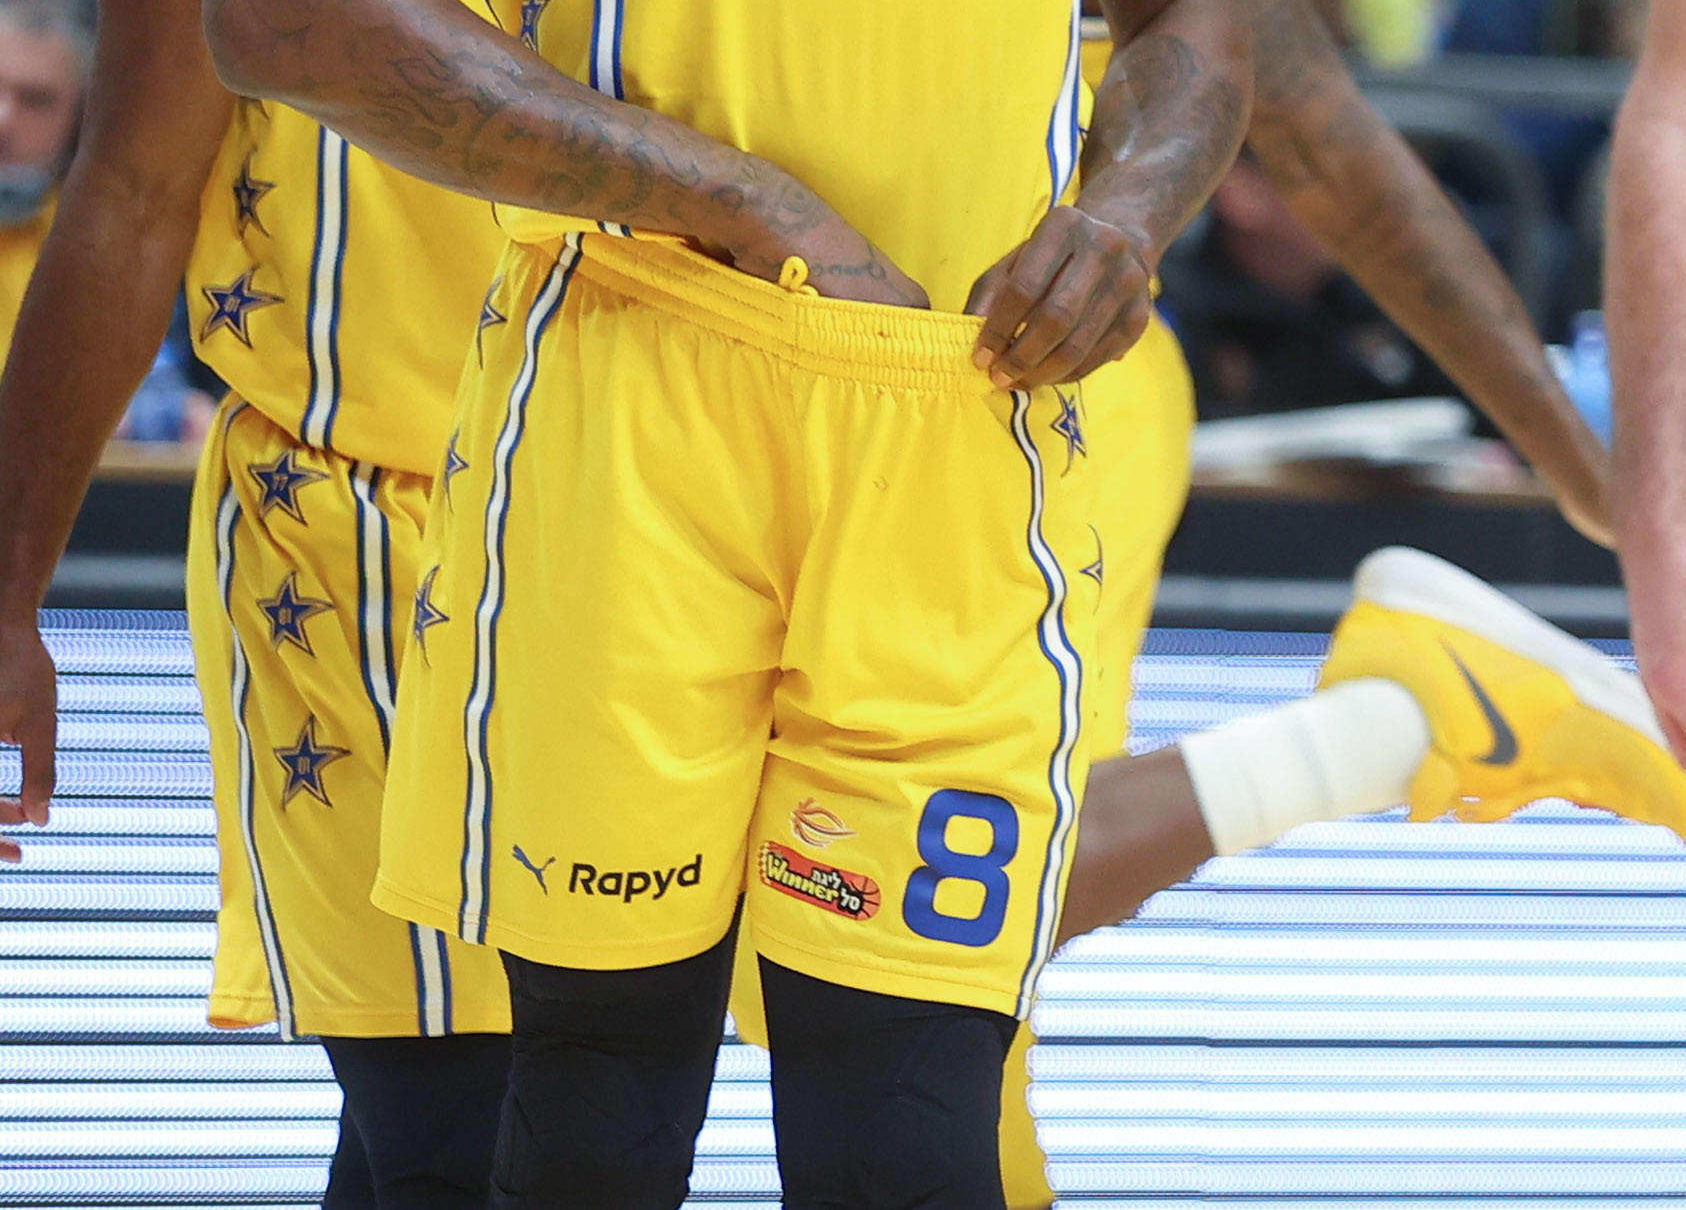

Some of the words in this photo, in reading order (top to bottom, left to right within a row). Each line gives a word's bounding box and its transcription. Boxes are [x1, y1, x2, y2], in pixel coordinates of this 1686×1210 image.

[569, 854, 702, 904] Rapyd
[767, 853, 839, 902] Winner
[841, 887, 861, 911] סל
[902, 788, 1019, 948] 8
